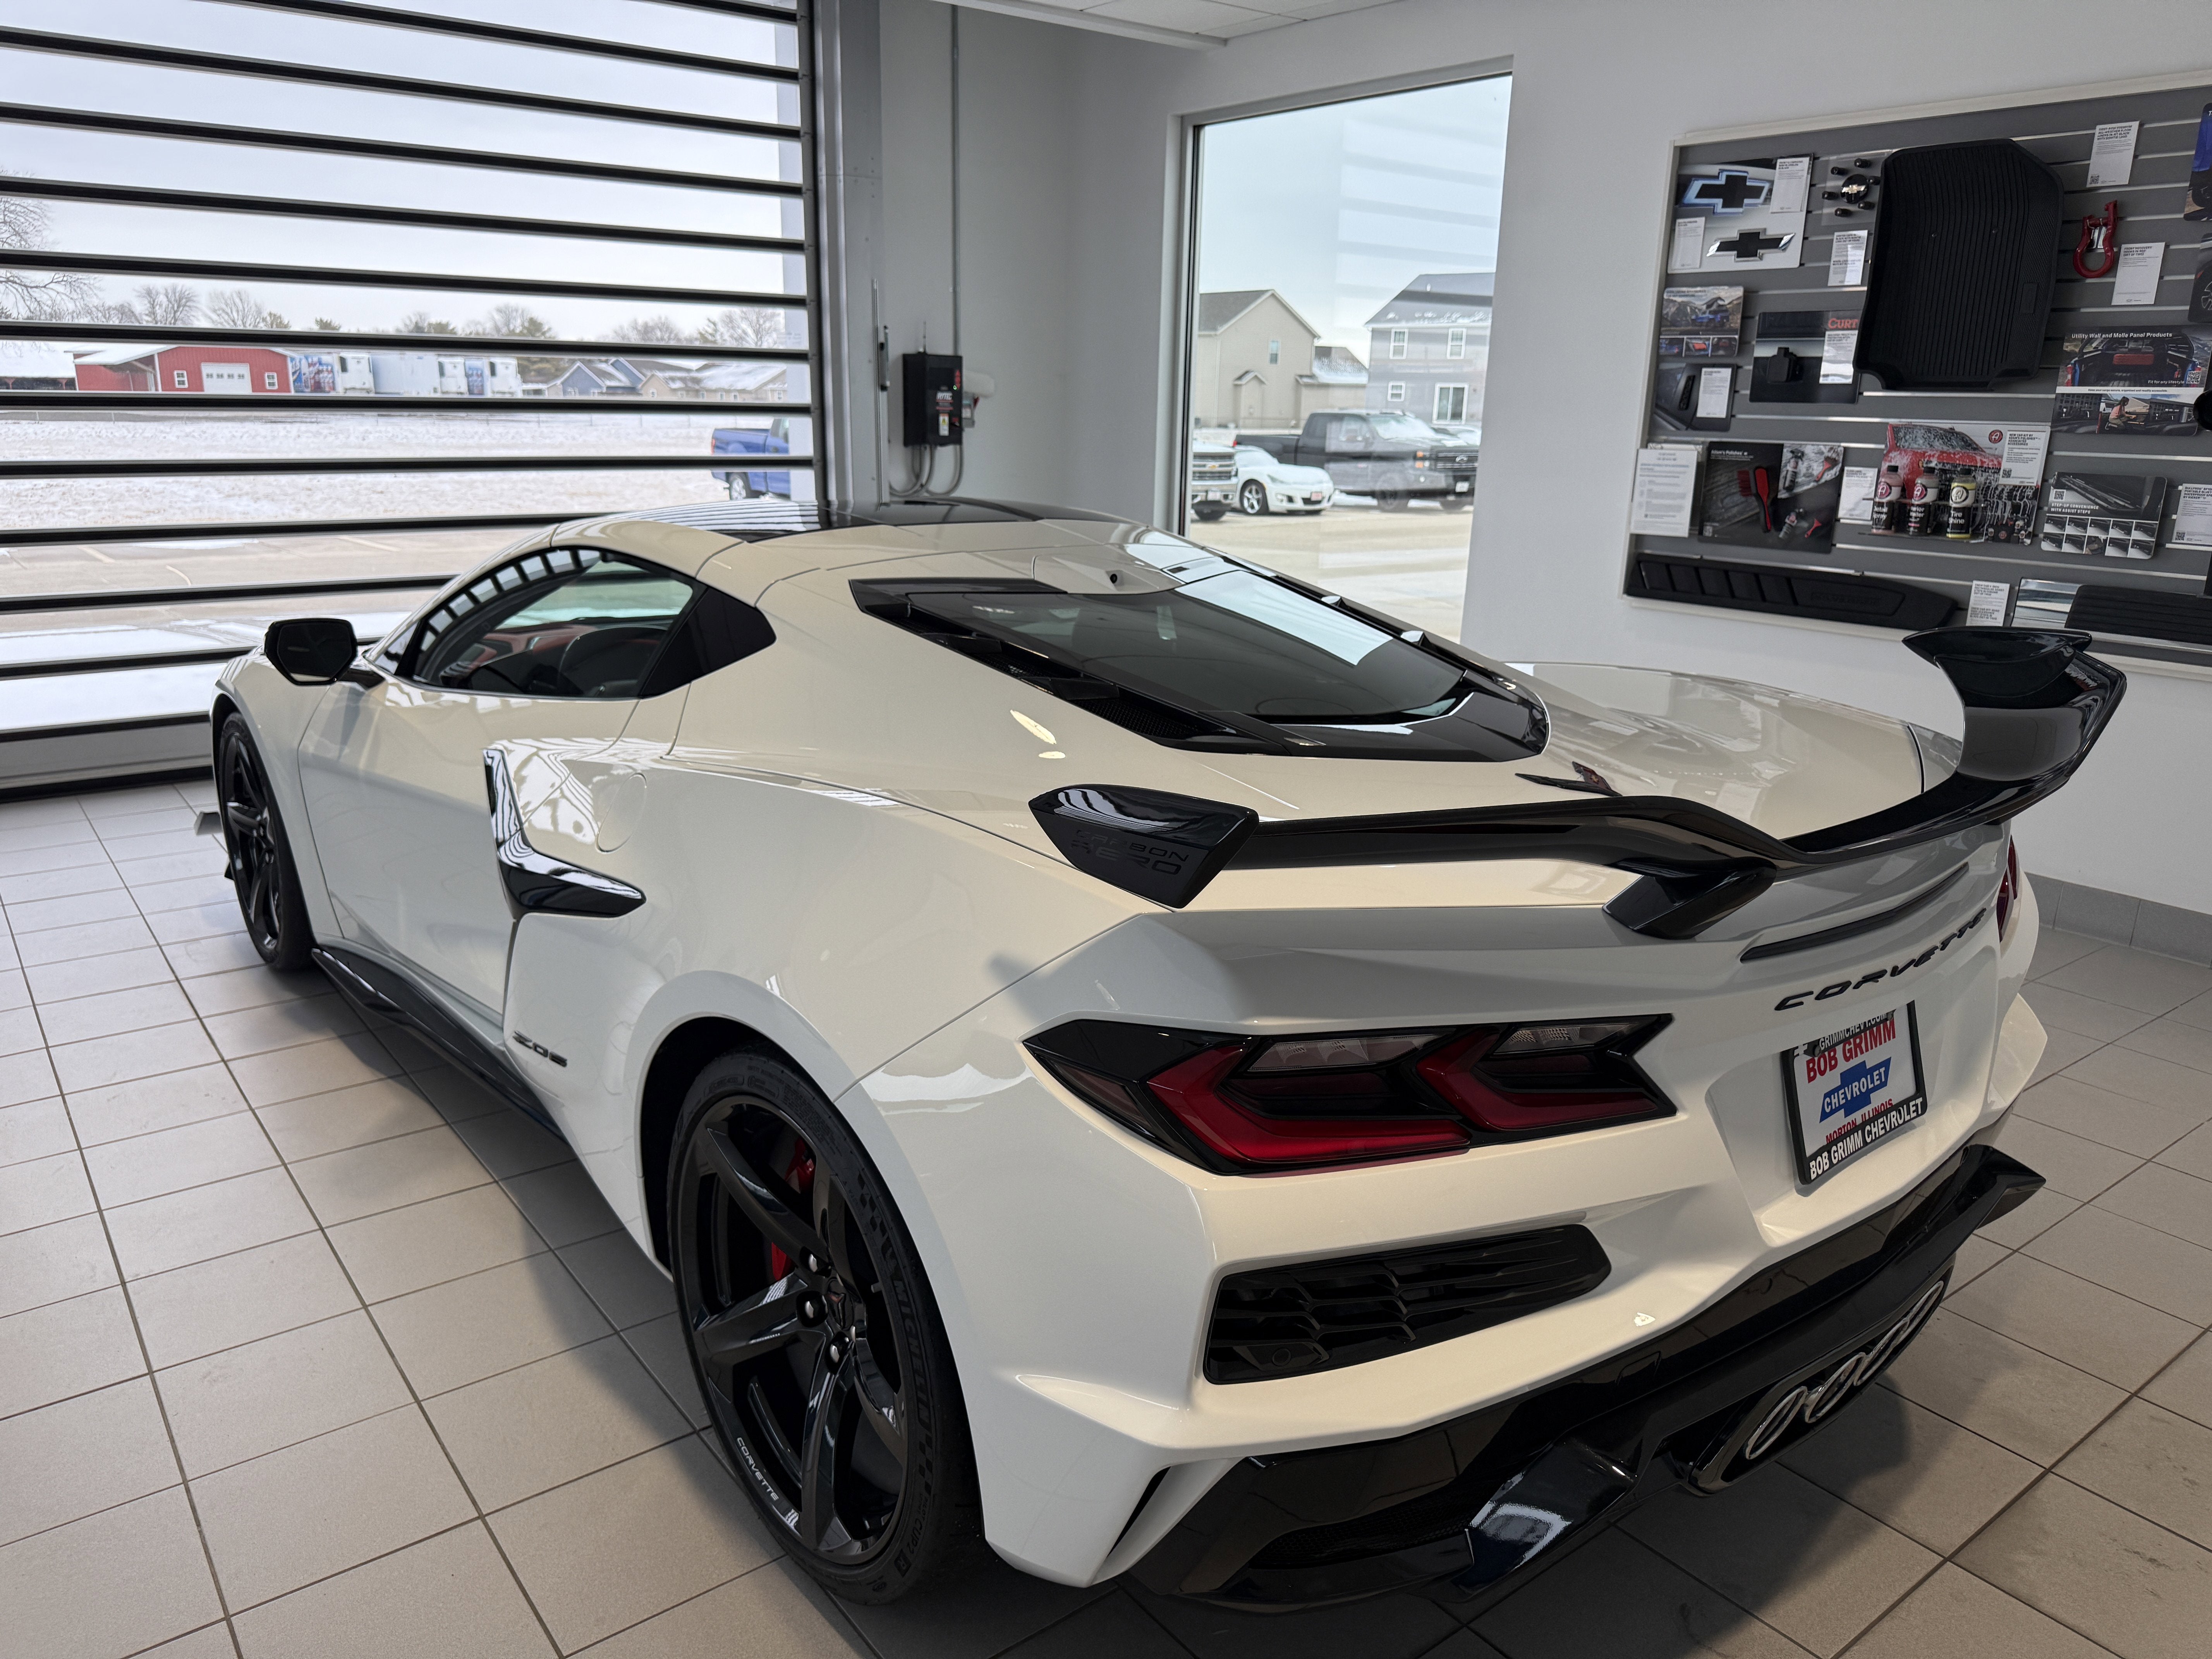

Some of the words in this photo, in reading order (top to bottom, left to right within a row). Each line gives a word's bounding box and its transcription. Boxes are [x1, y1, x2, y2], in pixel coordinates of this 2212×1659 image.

[1828, 318, 1859, 329] CURT
[1070, 839, 1182, 875] AERO
[1075, 829, 1190, 862] CARBON
[1774, 908, 1987, 1011] CORVETTE
[1806, 1047, 1838, 1084] BOB
[1842, 1016, 1896, 1063] GRIMM
[1824, 1066, 1886, 1113] CHEVROLET
[1810, 1151, 1830, 1180] BOB
[1831, 1130, 1863, 1164] GRIMM
[1865, 1097, 1923, 1143] CHEVROLET
[1826, 1118, 1857, 1144] MORTON
[1861, 1099, 1894, 1123] ILLINOIS
[892, 1278, 932, 1427] MICHELIN
[735, 1436, 779, 1501] CORVETTE
